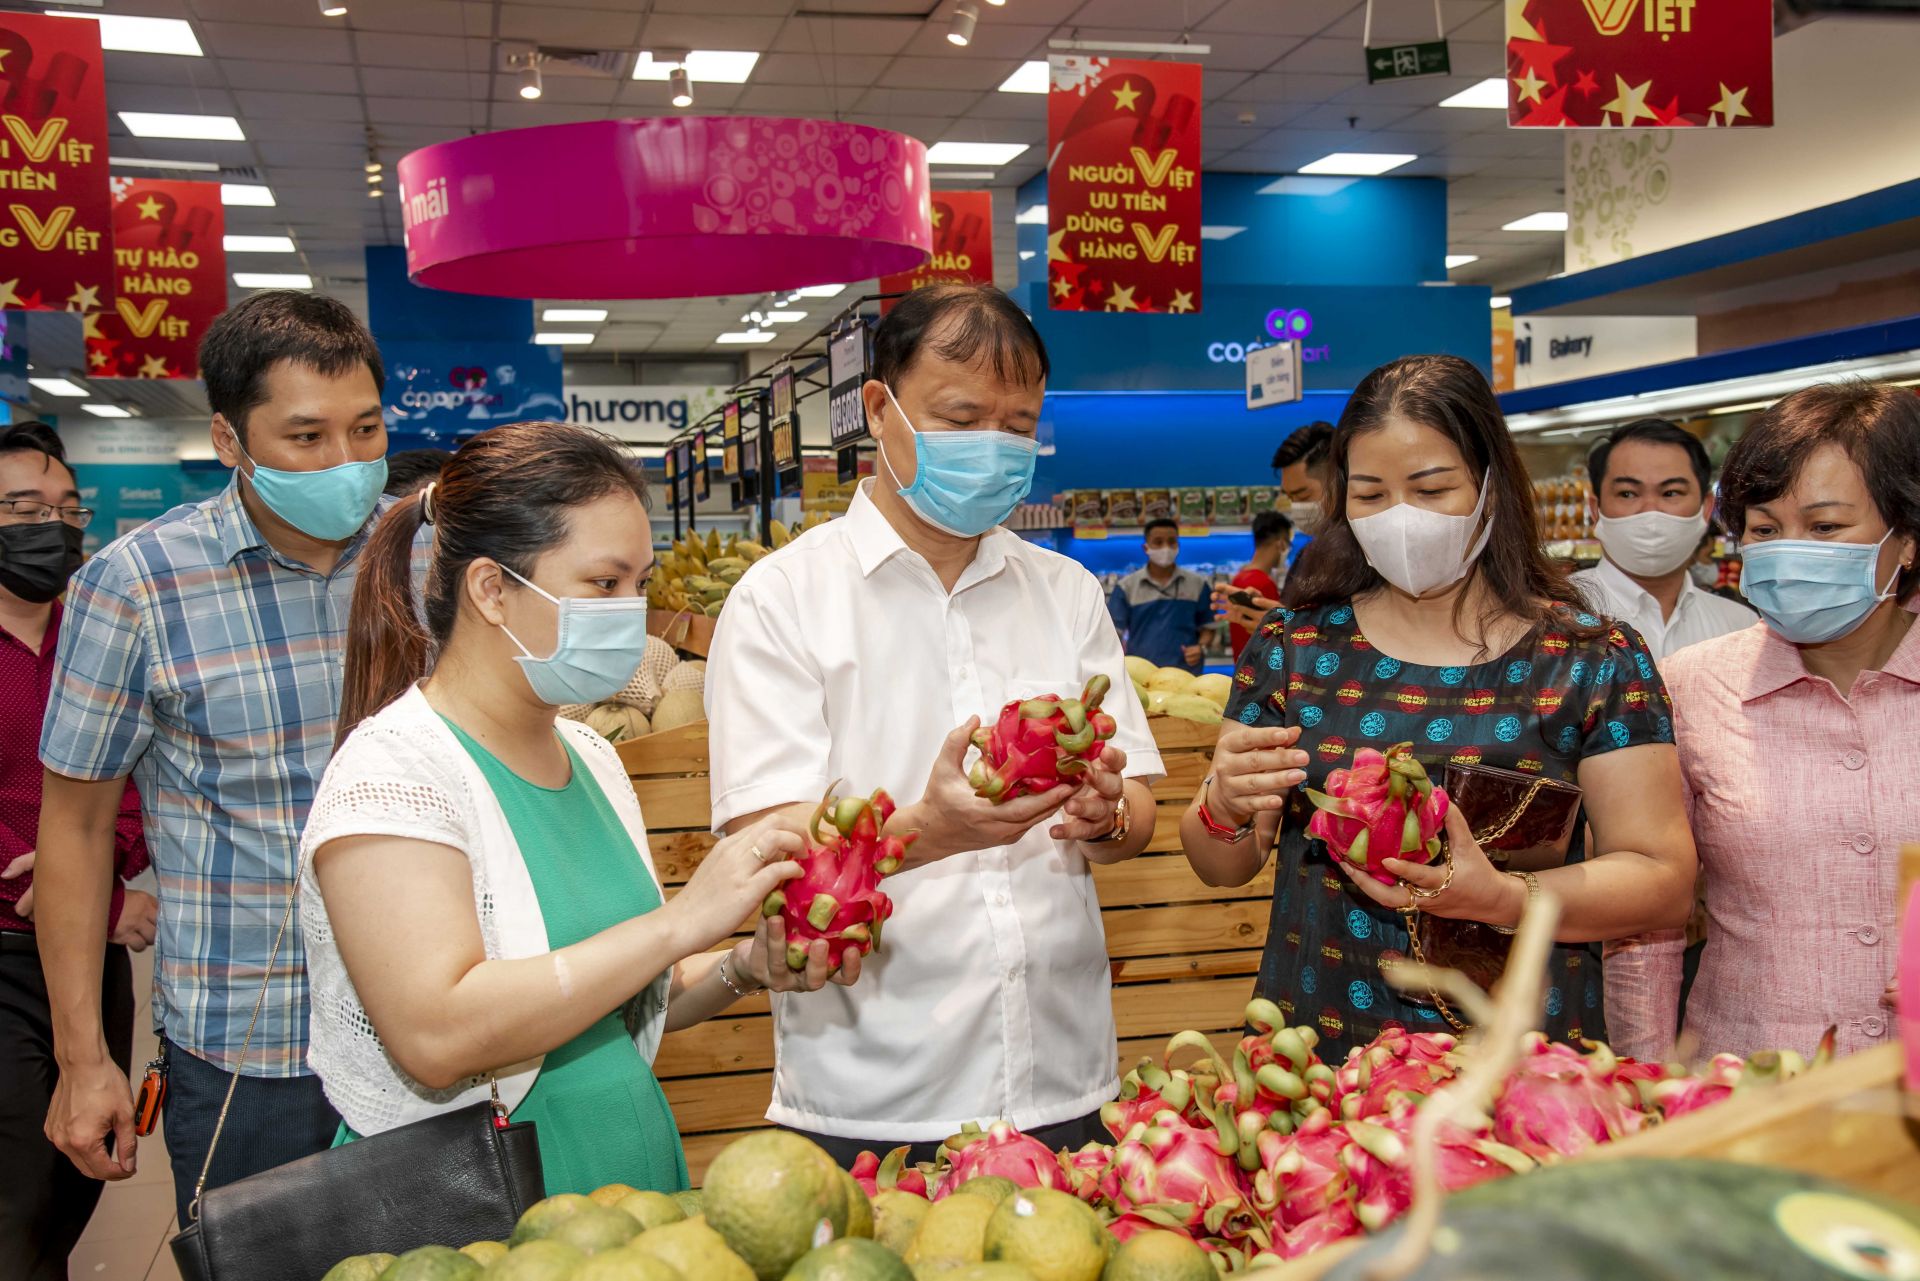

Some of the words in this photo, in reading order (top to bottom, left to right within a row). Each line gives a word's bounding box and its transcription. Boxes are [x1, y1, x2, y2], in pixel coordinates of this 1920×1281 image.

[2, 115, 94, 167] VIỆT
[1130, 146, 1195, 191] VIỆT
[1122, 190, 1166, 211] TIÊN
[9, 204, 101, 255] VIỆT
[1066, 211, 1125, 233] DÙNG
[1080, 237, 1138, 259] HÀNG
[1130, 222, 1196, 266] VIỆT
[115, 247, 143, 271] TỰ
[148, 246, 199, 269] HÀO
[931, 250, 971, 270] HÀO
[124, 272, 192, 295] HÀNG
[115, 297, 190, 341] VIỆT
[1549, 335, 1593, 359] Bakery
